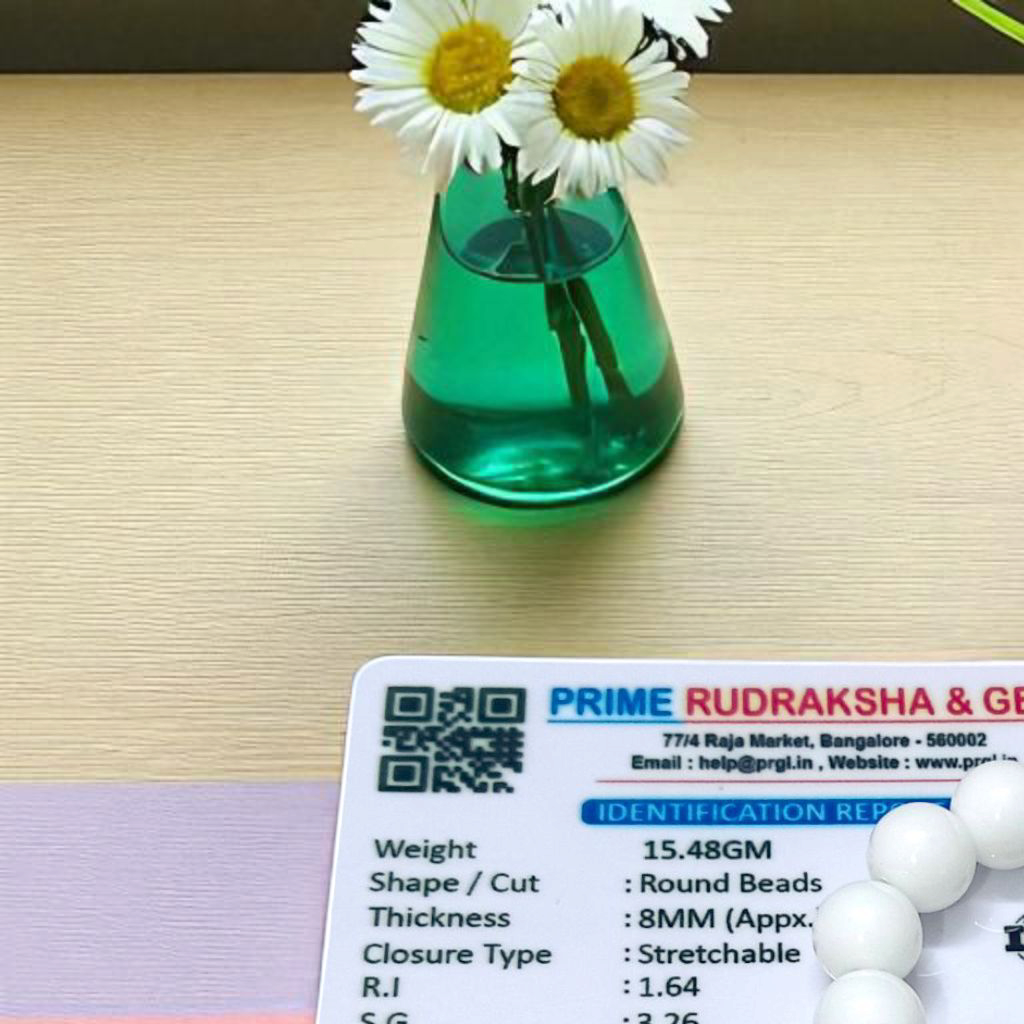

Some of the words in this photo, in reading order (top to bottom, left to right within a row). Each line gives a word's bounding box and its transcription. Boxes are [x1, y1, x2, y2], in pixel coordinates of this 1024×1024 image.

[551, 687, 673, 717] PRIME
[686, 686, 935, 717] RUDRAKSHA
[947, 687, 973, 716] &
[663, 733, 700, 748] 77/4
[704, 733, 745, 751] Raja
[749, 733, 815, 749] Market,
[820, 733, 910, 751] Bangalore
[926, 732, 987, 748] 560002
[631, 755, 682, 770] Email
[828, 754, 900, 770] Website
[600, 803, 826, 822] IDENTIFICATION
[374, 838, 478, 864] Weight
[643, 839, 773, 860] 15.48GM
[369, 871, 460, 898] Shape
[490, 872, 541, 893] Cut
[640, 872, 730, 893] Round
[740, 871, 823, 893] Beads
[369, 906, 511, 928] Thickness
[638, 908, 715, 929] 8MM
[363, 942, 474, 965] Closure
[483, 943, 552, 970] Type
[638, 942, 801, 964] Stretchable
[362, 976, 400, 998] R.I
[639, 976, 700, 997] 1.64
